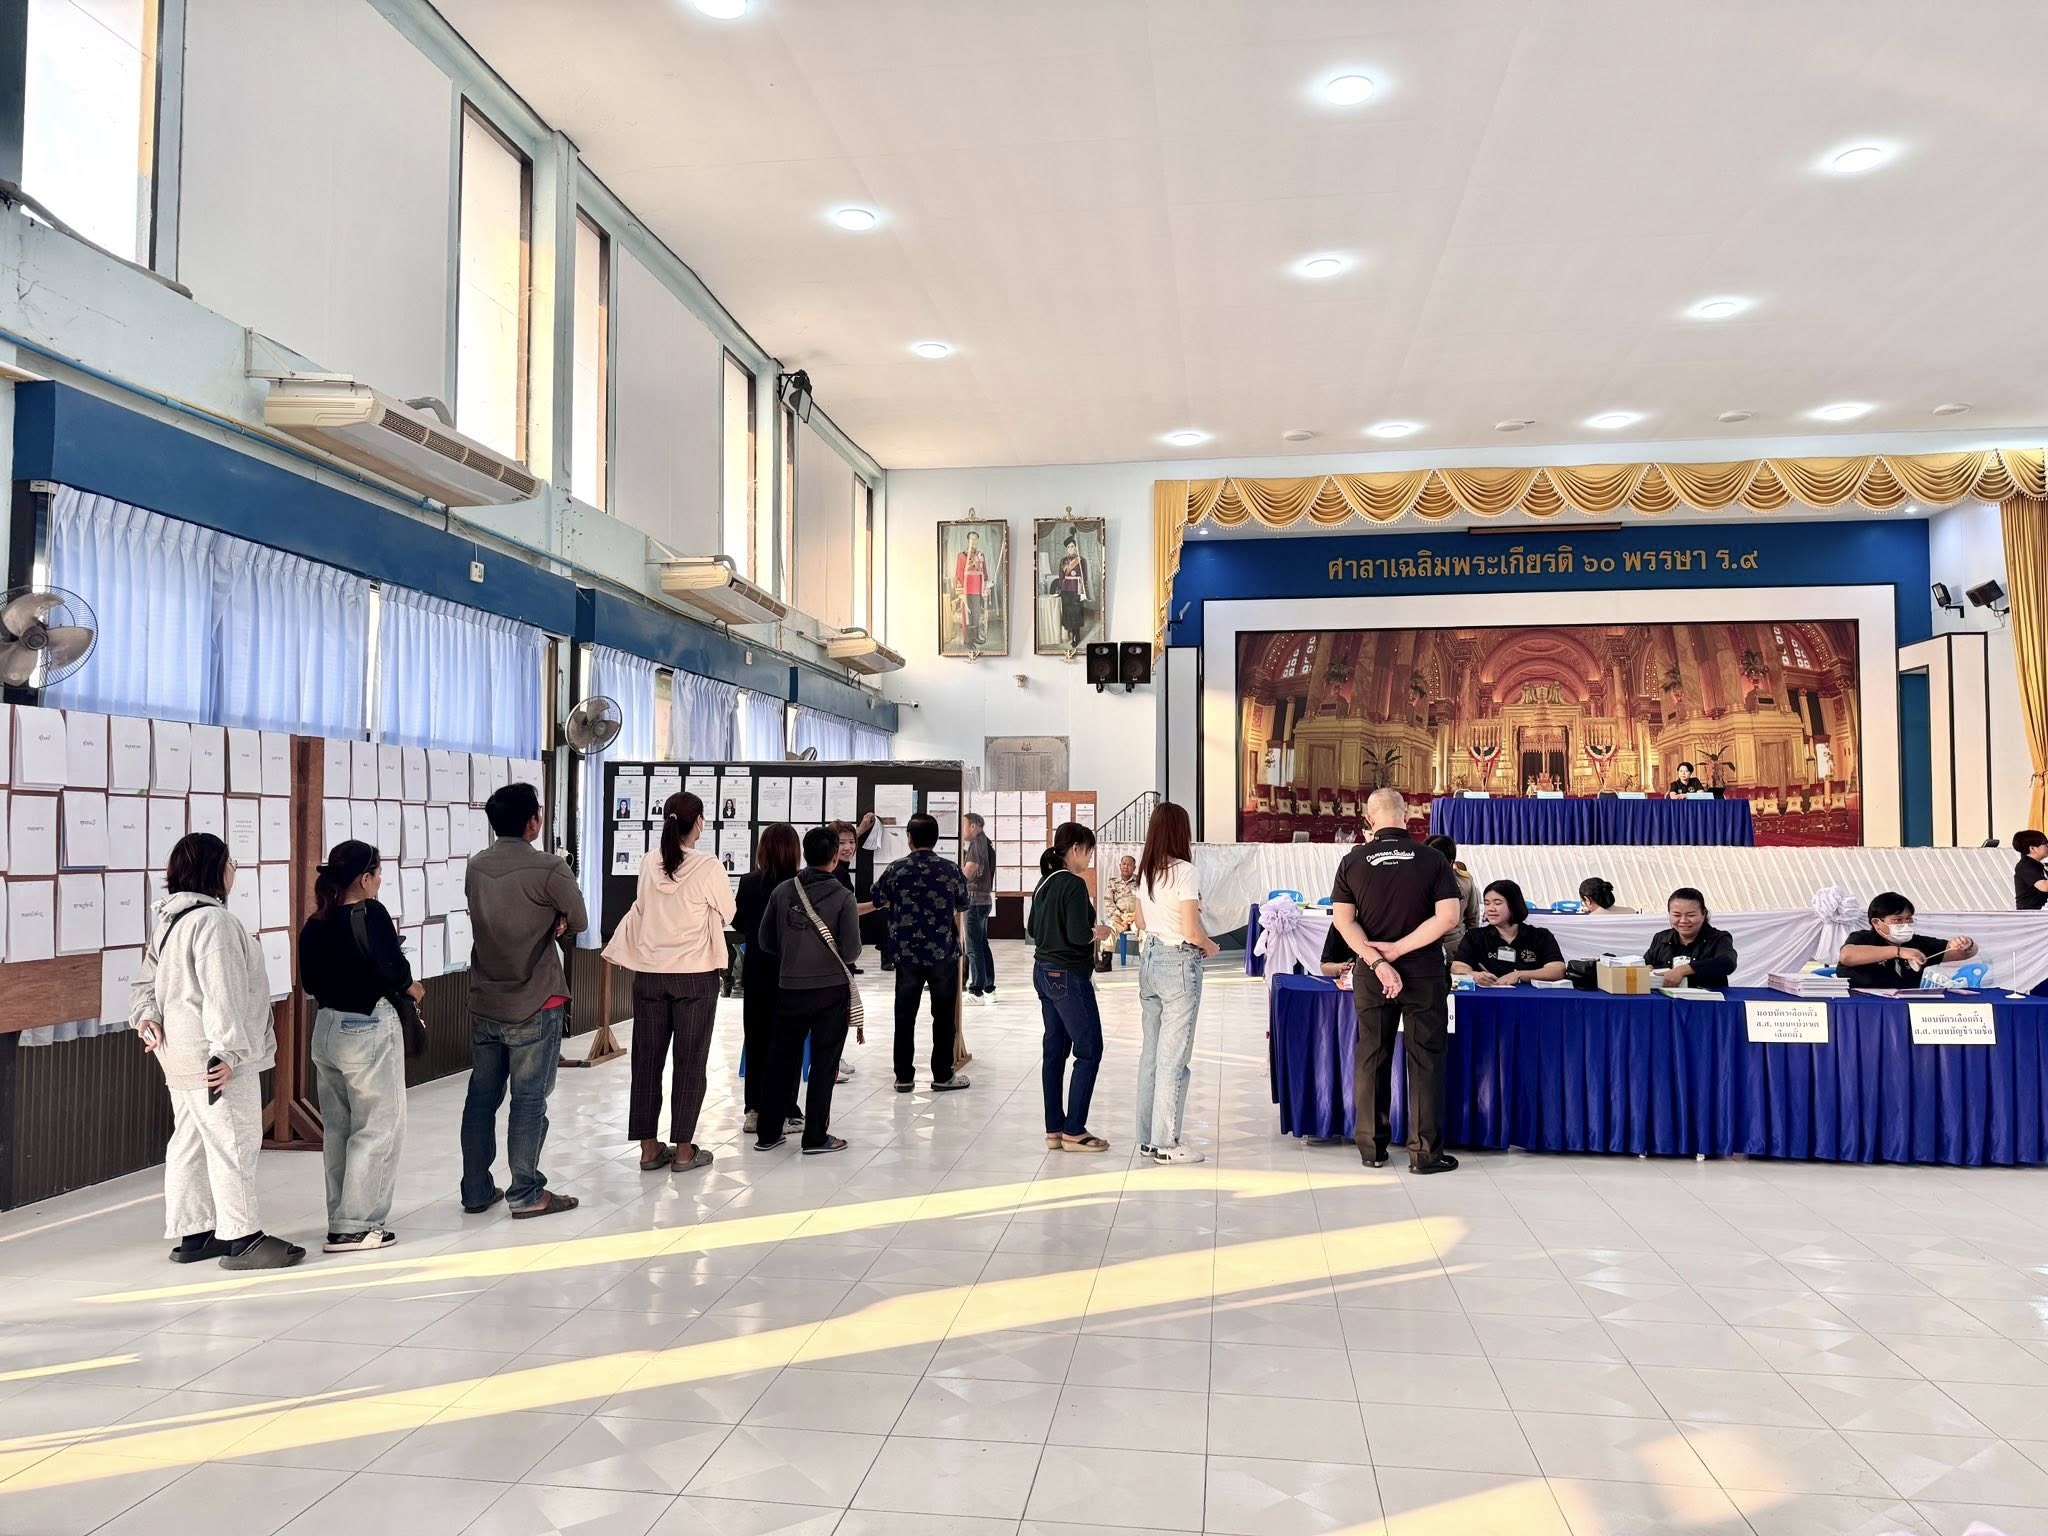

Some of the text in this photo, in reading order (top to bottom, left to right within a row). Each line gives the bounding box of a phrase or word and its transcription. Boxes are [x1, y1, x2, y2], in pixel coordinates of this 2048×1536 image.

[1328, 545, 1759, 579] ศาลาเฉลิมพระเกียรติ ๖๐ พรรษา ร.๙
[1921, 1010, 1983, 1023] มอบบัตรเลือกตั้ง
